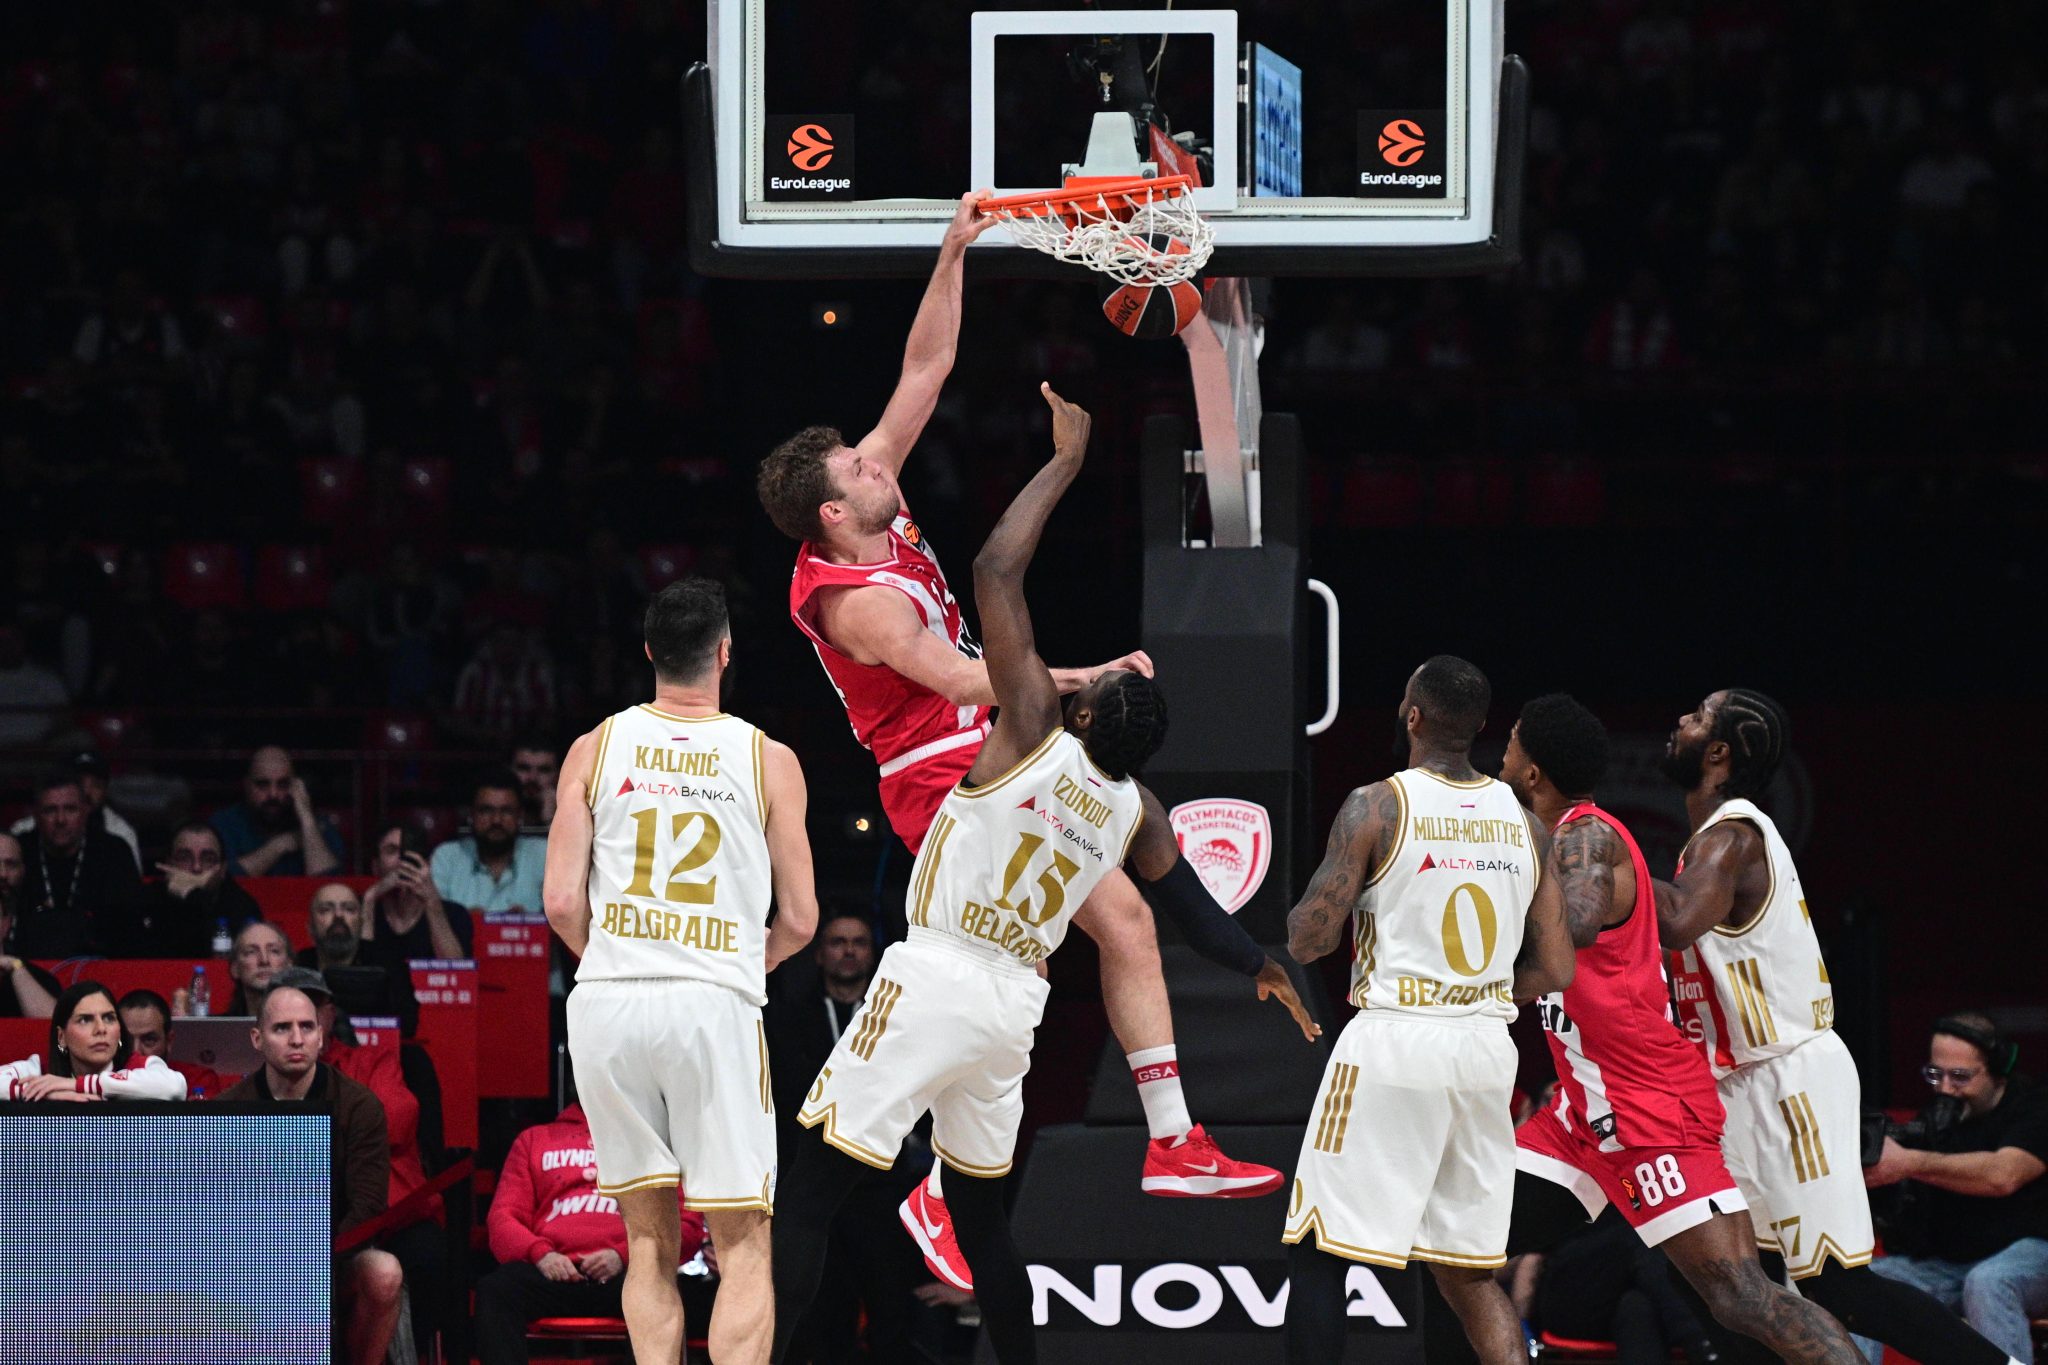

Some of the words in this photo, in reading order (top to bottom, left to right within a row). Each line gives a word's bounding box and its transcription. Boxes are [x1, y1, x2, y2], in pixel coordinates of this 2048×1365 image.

[770, 176, 851, 193] EuroLeague
[1360, 172, 1442, 189] EuroLeague
[635, 745, 720, 778] KALINIĆ
[1052, 772, 1113, 830] IZUNDU
[1180, 808, 1257, 825] OLYMPIACOS
[1190, 821, 1247, 833] BASKETBALL
[1413, 816, 1524, 849] MILLER-MCINTYRE
[622, 807, 721, 905] 12
[993, 831, 1081, 929] 15
[600, 902, 739, 953] BELGRADE
[1441, 882, 1498, 978] 0
[1138, 1065, 1176, 1082] GSA
[541, 1148, 597, 1172] OLYMP
[1634, 1153, 1687, 1207] 88
[1025, 1262, 1409, 1329] NOVA
